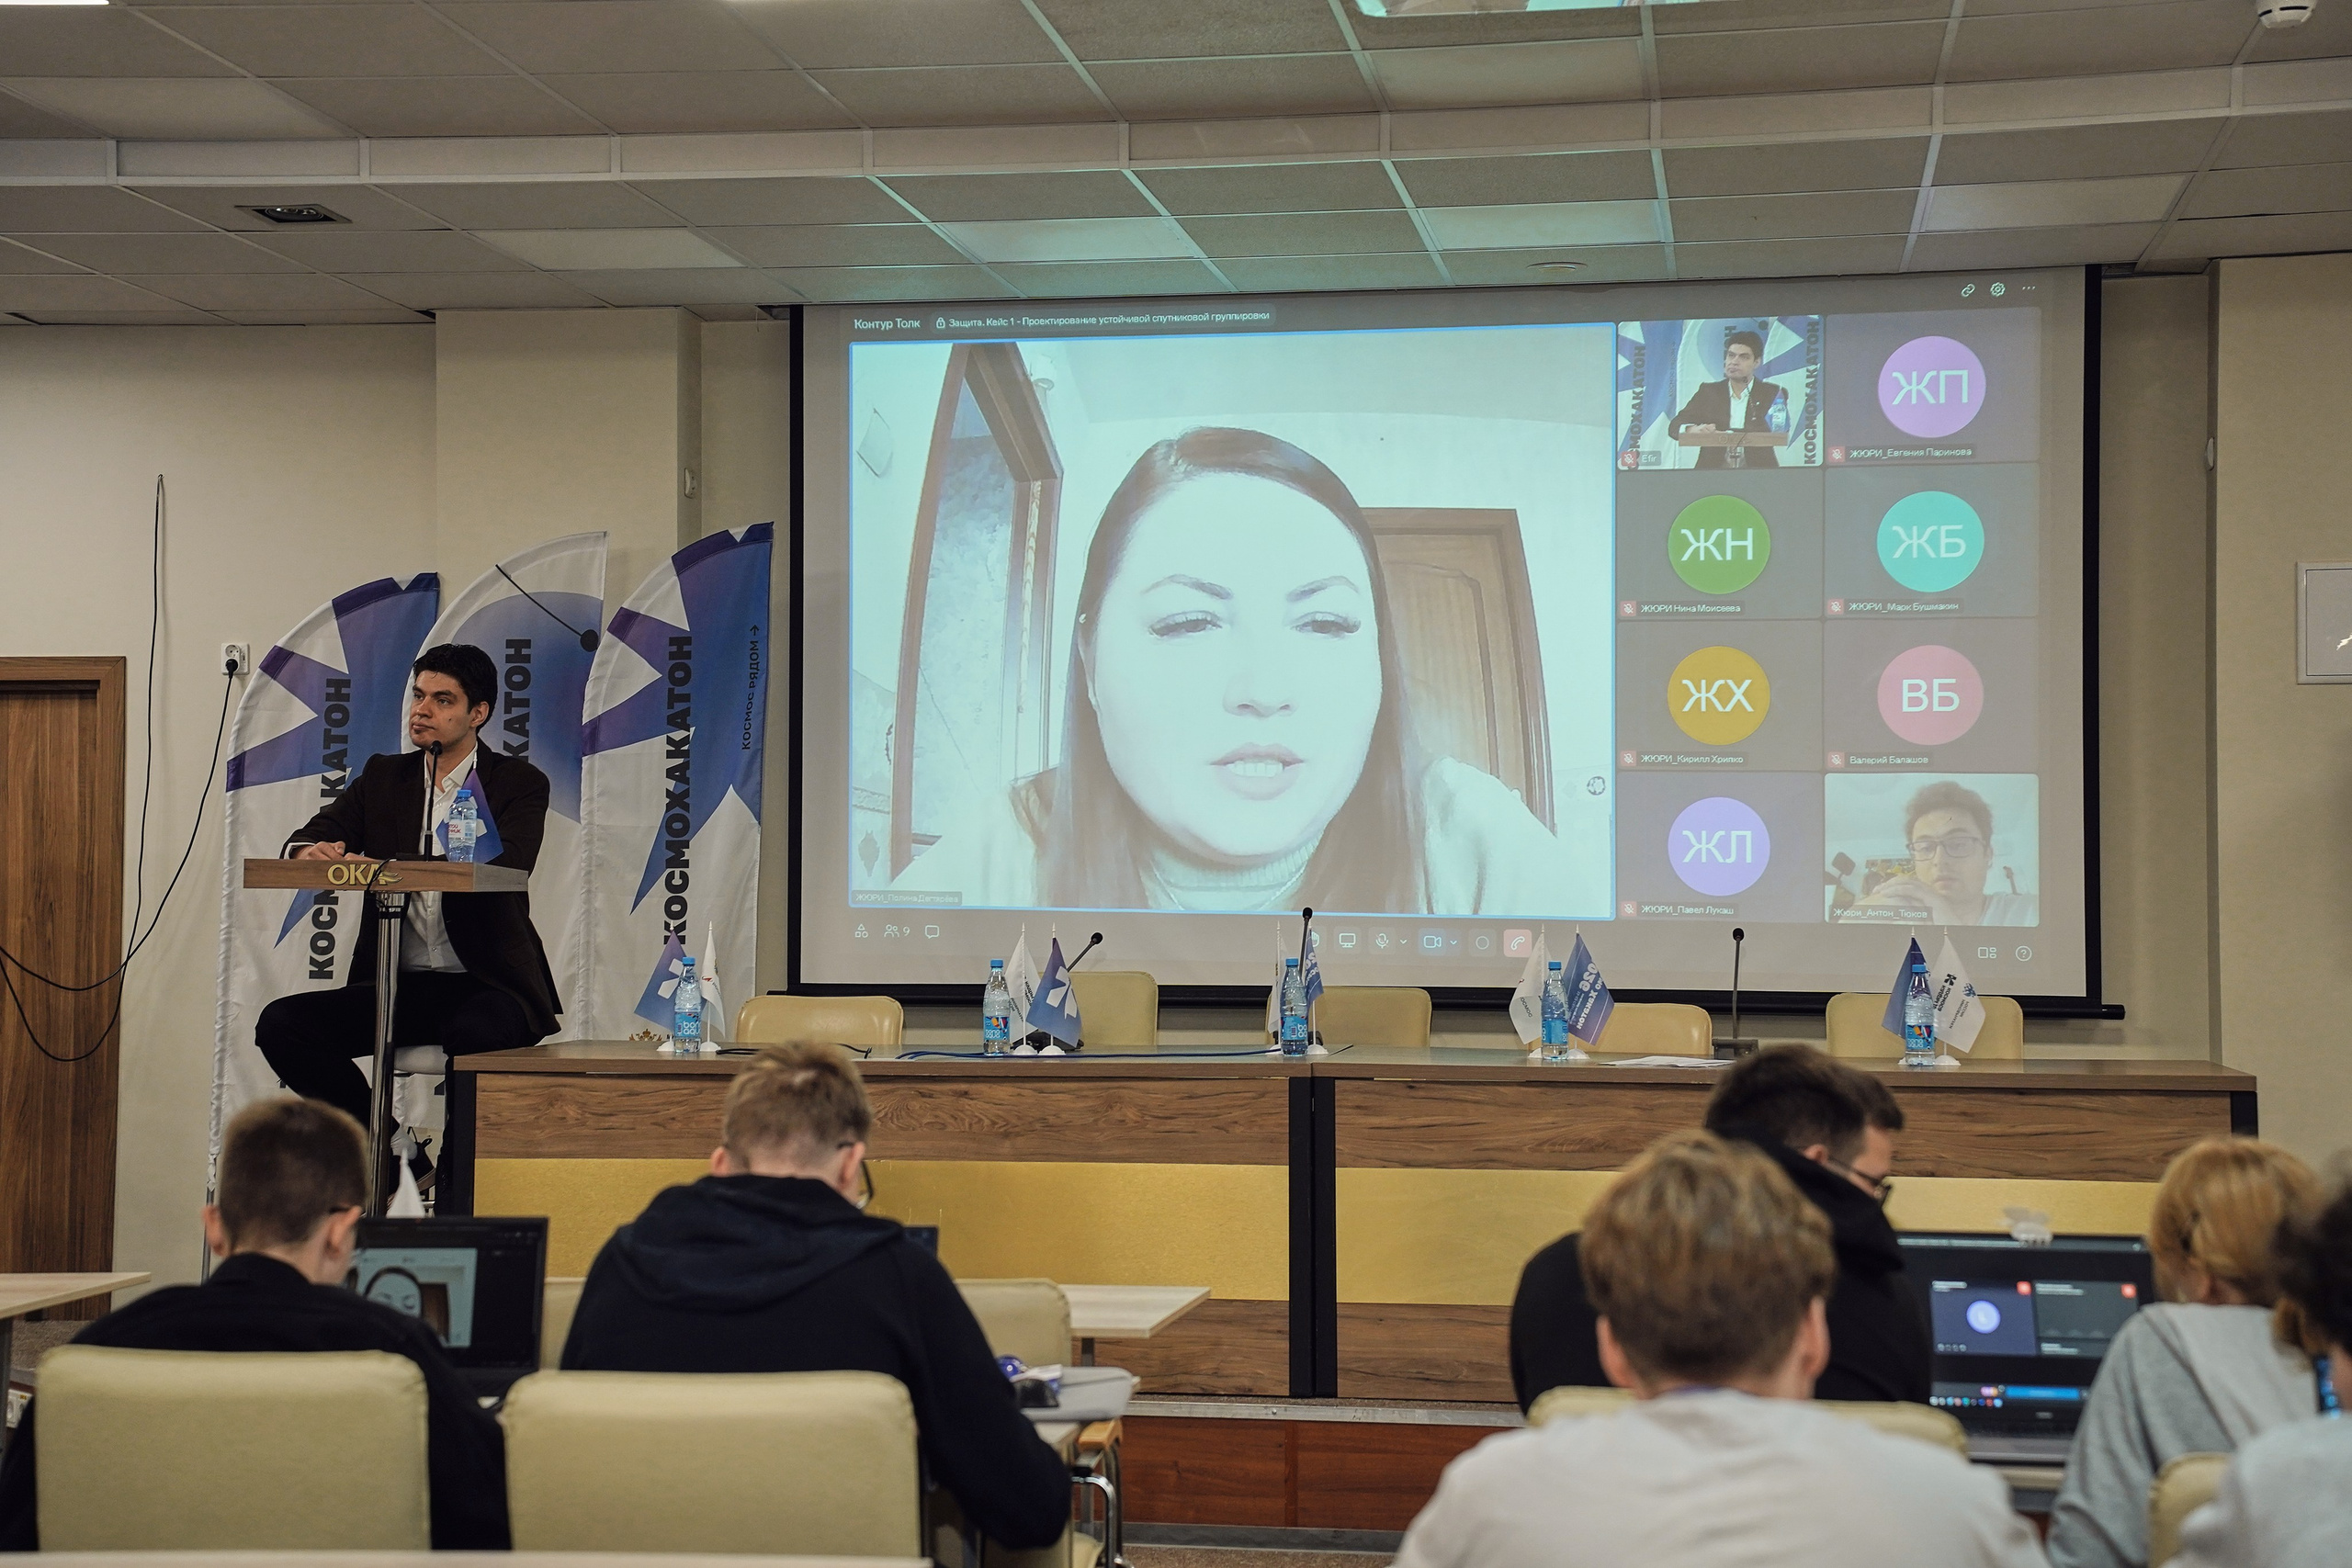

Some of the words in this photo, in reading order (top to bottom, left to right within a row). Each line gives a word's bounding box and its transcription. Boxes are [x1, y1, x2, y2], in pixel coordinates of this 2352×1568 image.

[854, 319, 893, 331] Контур
[896, 318, 921, 329] Толк
[949, 318, 985, 328] Защита.
[986, 317, 1009, 327] Кейс
[1010, 317, 1014, 326] 1
[1023, 315, 1097, 327] Проектирование
[1099, 313, 1150, 325] устойчивой
[1152, 312, 1210, 324] спутниковой
[1211, 311, 1270, 322] группировки
[1892, 370, 1969, 405] ЖП
[1849, 448, 1925, 459] ЖЮРИ_Евгения
[1926, 447, 1973, 458] Паринова
[1680, 527, 1753, 561] ЖН
[1892, 525, 1966, 558] ЖБ
[1849, 603, 1912, 613] ЖЮРИ_Марк
[1913, 602, 1959, 612] Бушмакин
[741, 691, 755, 750] КОСМОС
[748, 639, 760, 689] РЯДОМ
[1681, 679, 1755, 712] ЖХ
[1902, 678, 1961, 712] ВБ
[1641, 755, 1710, 765] ЖЮРИ_Кирилл
[1849, 755, 1888, 765] Валерий
[1889, 755, 1928, 764] Балашов
[662, 636, 693, 945] КОСМОХАКАТОН
[1682, 830, 1752, 863] ЖЛ
[1641, 905, 1704, 916] ЖЮРИ_Павел
[1705, 906, 1734, 916] Лукаш
[902, 926, 910, 937] 9
